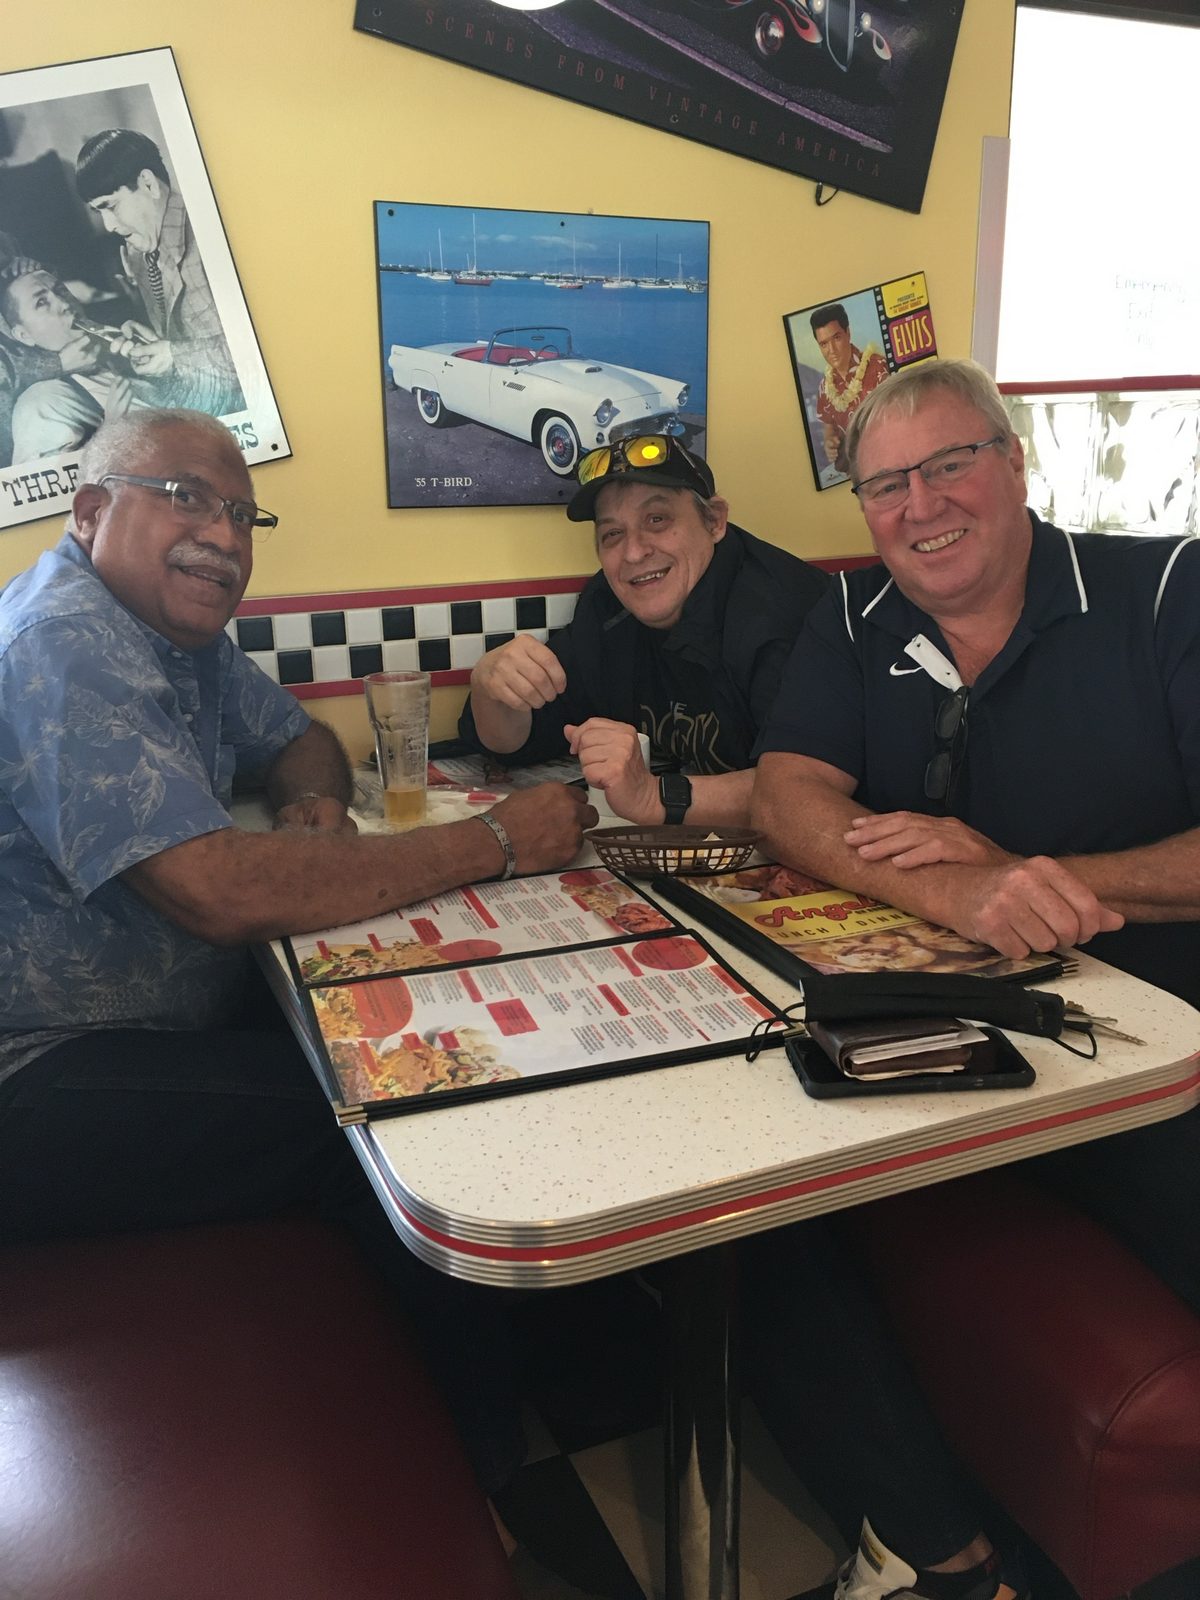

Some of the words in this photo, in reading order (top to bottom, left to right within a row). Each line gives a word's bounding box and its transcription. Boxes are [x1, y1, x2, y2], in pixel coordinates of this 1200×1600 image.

[425, 8, 534, 60] SCENES
[557, 54, 625, 91] FROM
[648, 85, 759, 136] VINTAGE
[776, 131, 881, 177] AMERICA
[892, 315, 933, 357] ELVIS
[414, 477, 427, 488] '55
[430, 476, 473, 488] T-BIRD
